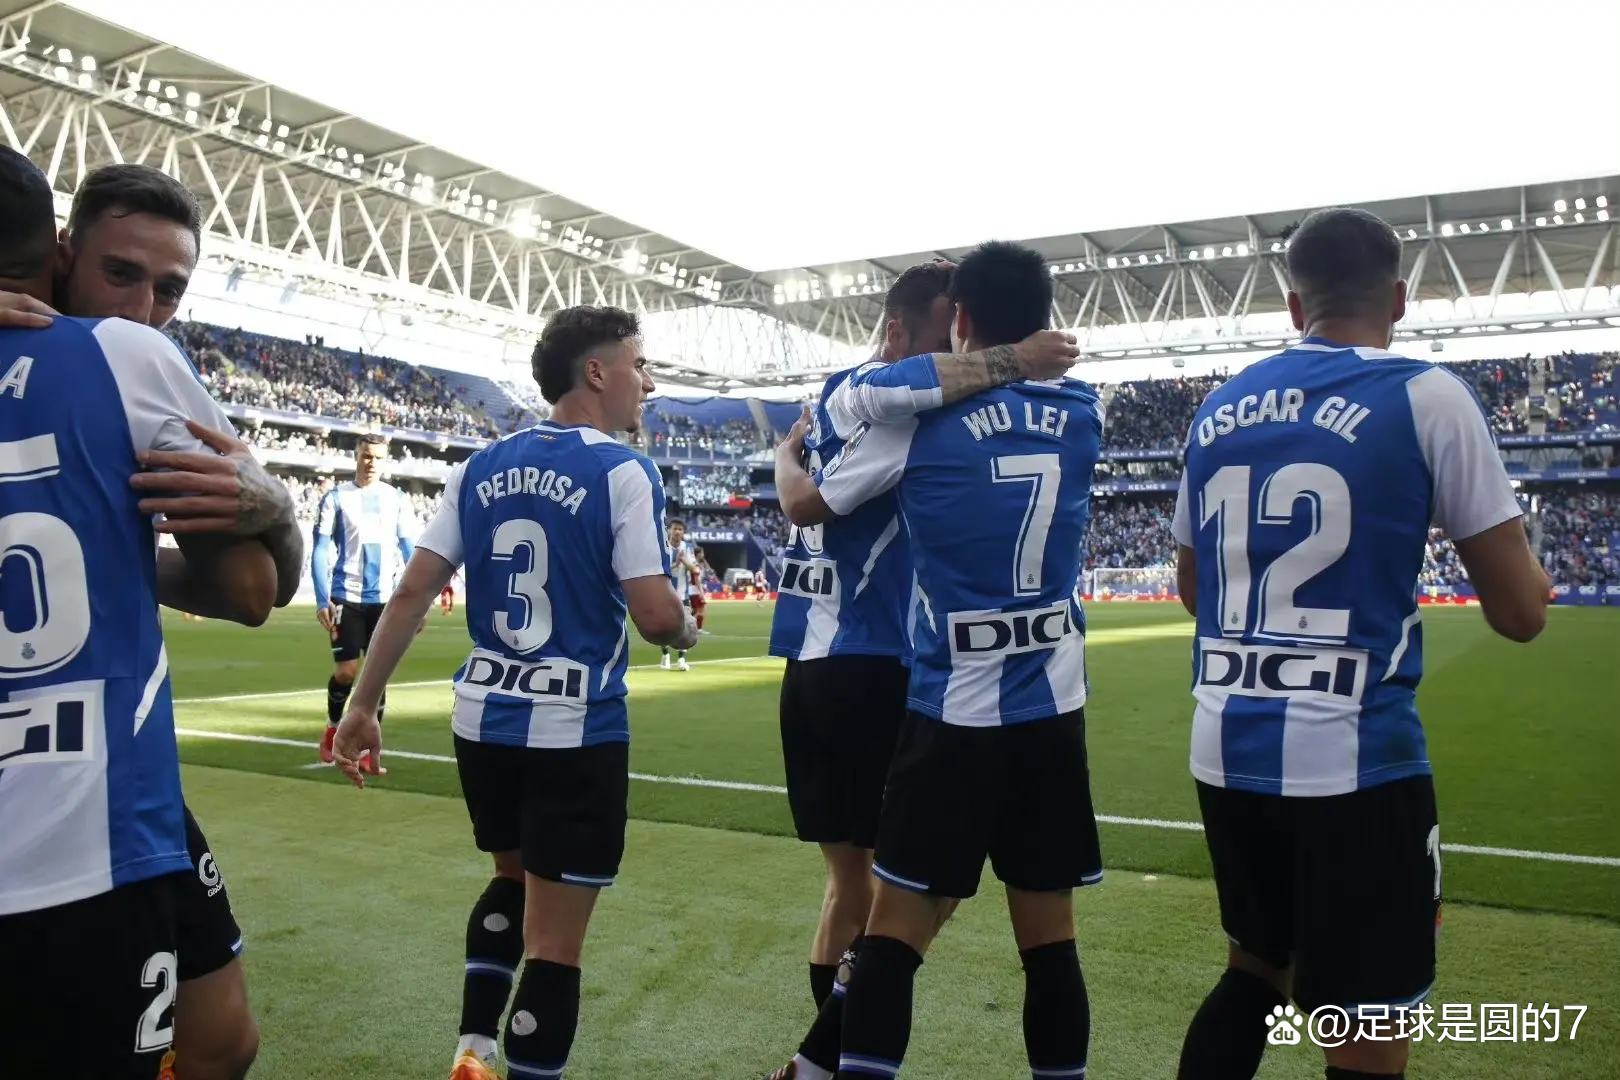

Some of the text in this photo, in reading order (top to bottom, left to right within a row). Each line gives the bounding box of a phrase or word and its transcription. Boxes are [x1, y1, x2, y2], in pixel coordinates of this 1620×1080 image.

[962, 401, 1069, 442] WU LEI
[1197, 387, 1371, 448] OSCAR GIL
[475, 466, 588, 516] PEDROSA
[691, 531, 733, 541] KELME
[989, 453, 1062, 597] 7
[1198, 462, 1351, 645] 12
[491, 518, 553, 655] 3
[463, 656, 582, 698] DIGI
[1200, 649, 1358, 697] DIGI
[134, 950, 178, 1053] 2
